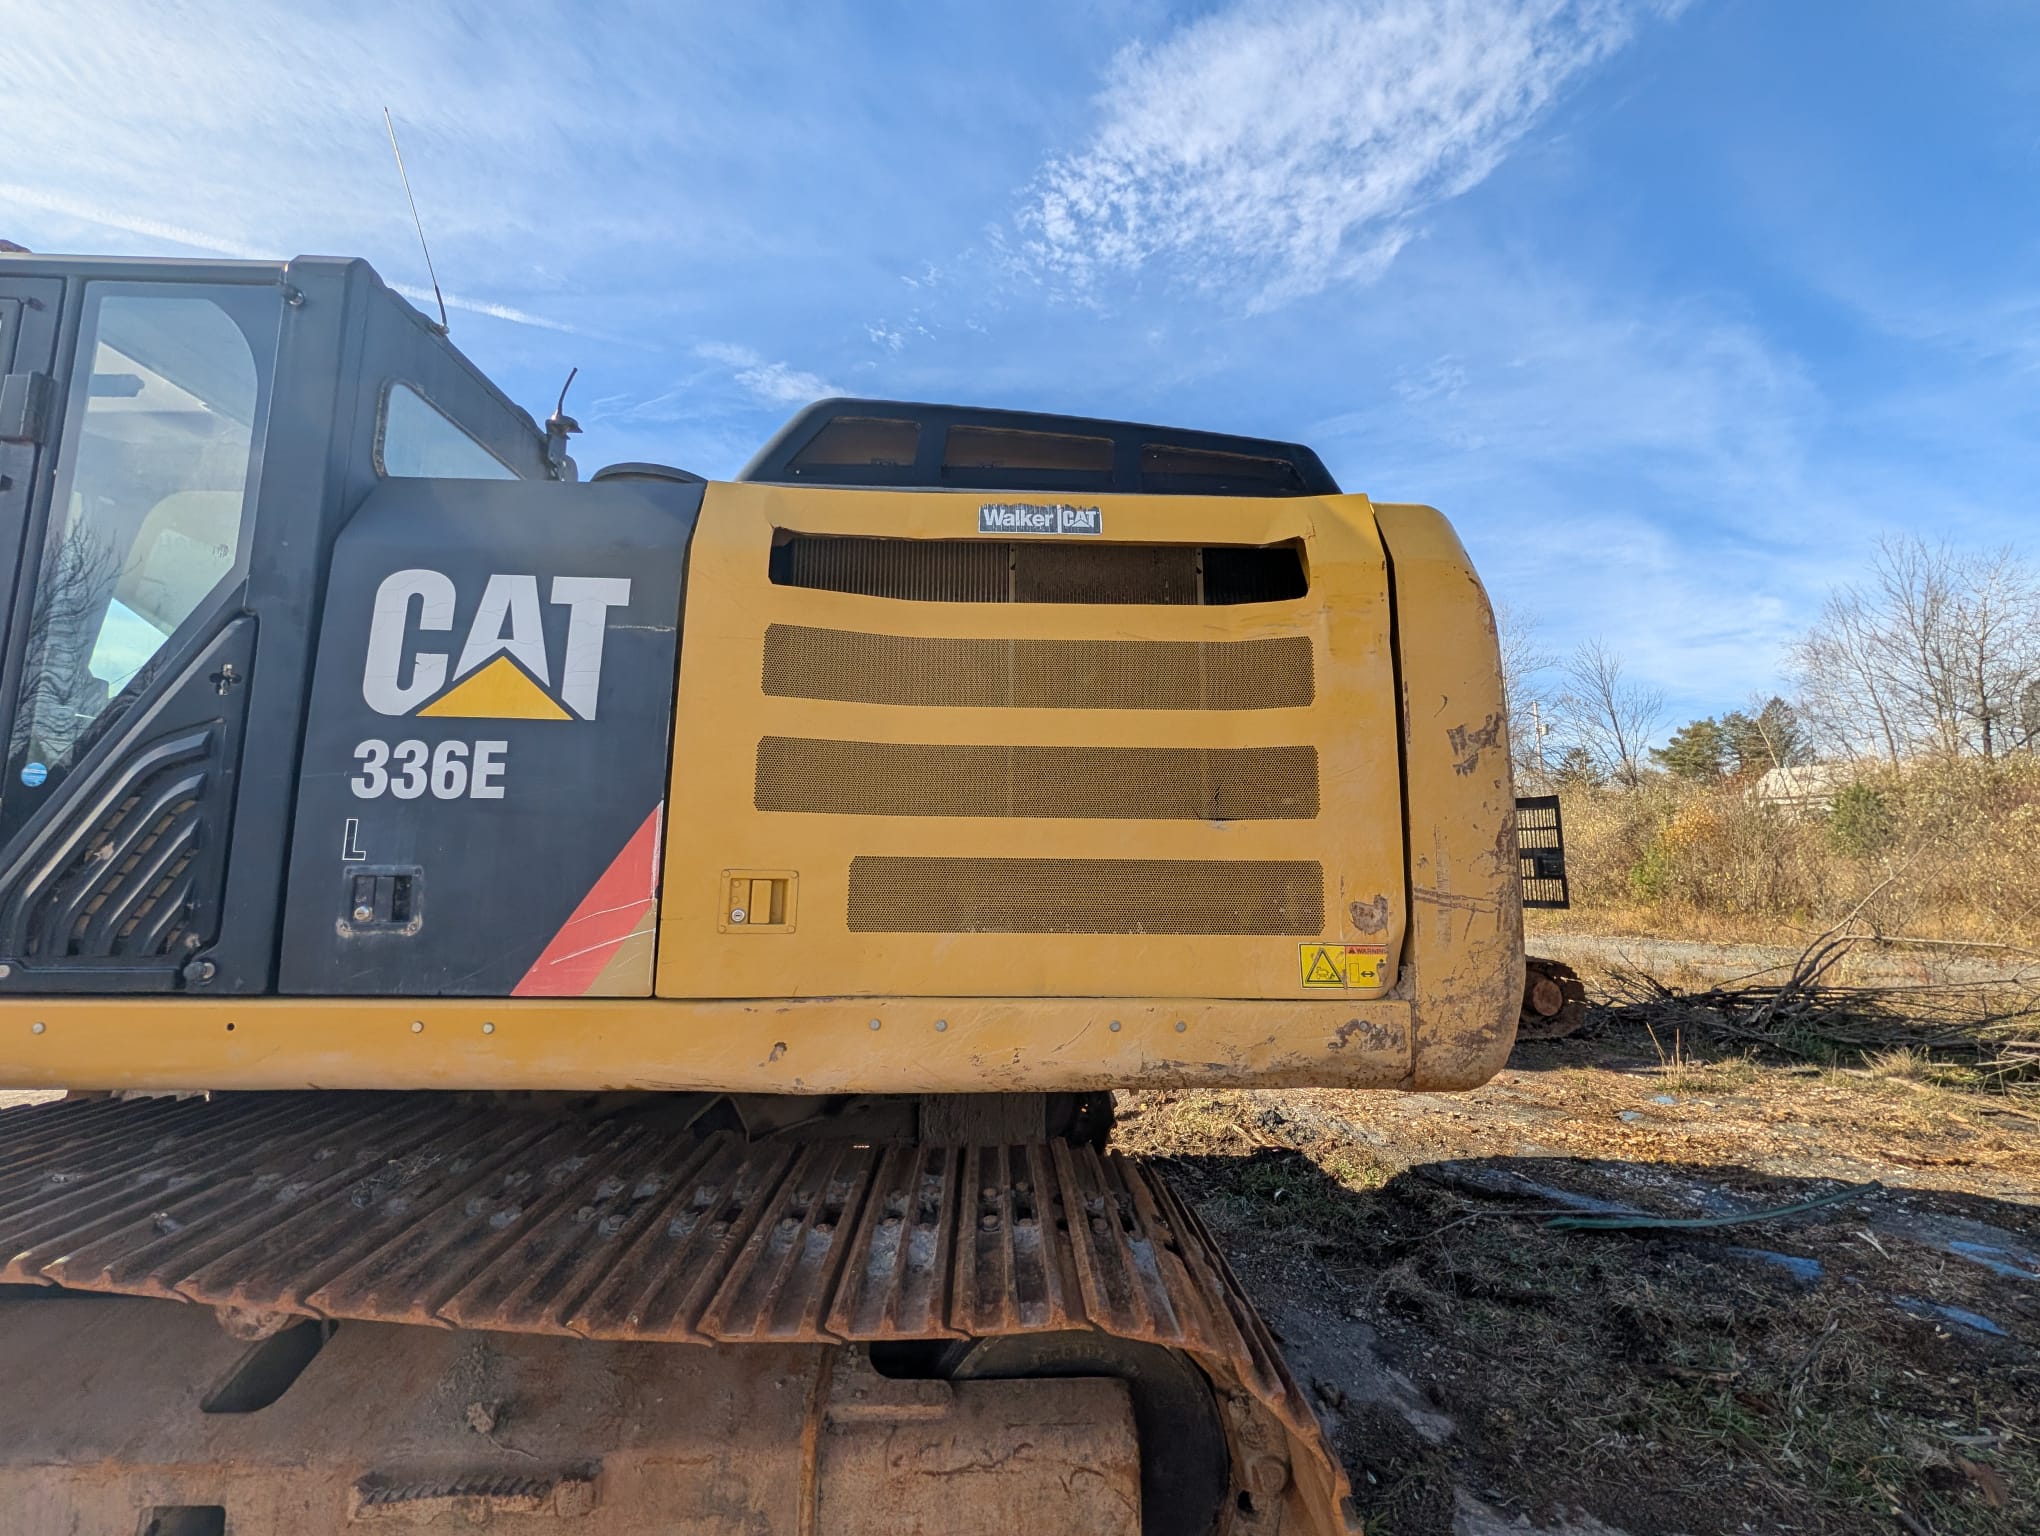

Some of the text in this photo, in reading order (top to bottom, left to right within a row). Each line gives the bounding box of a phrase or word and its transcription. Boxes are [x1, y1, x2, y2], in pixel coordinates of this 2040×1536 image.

[984, 509, 1096, 528] Walker CAT
[363, 569, 632, 721] CAT
[350, 739, 507, 799] 336E
[342, 818, 367, 861] L
